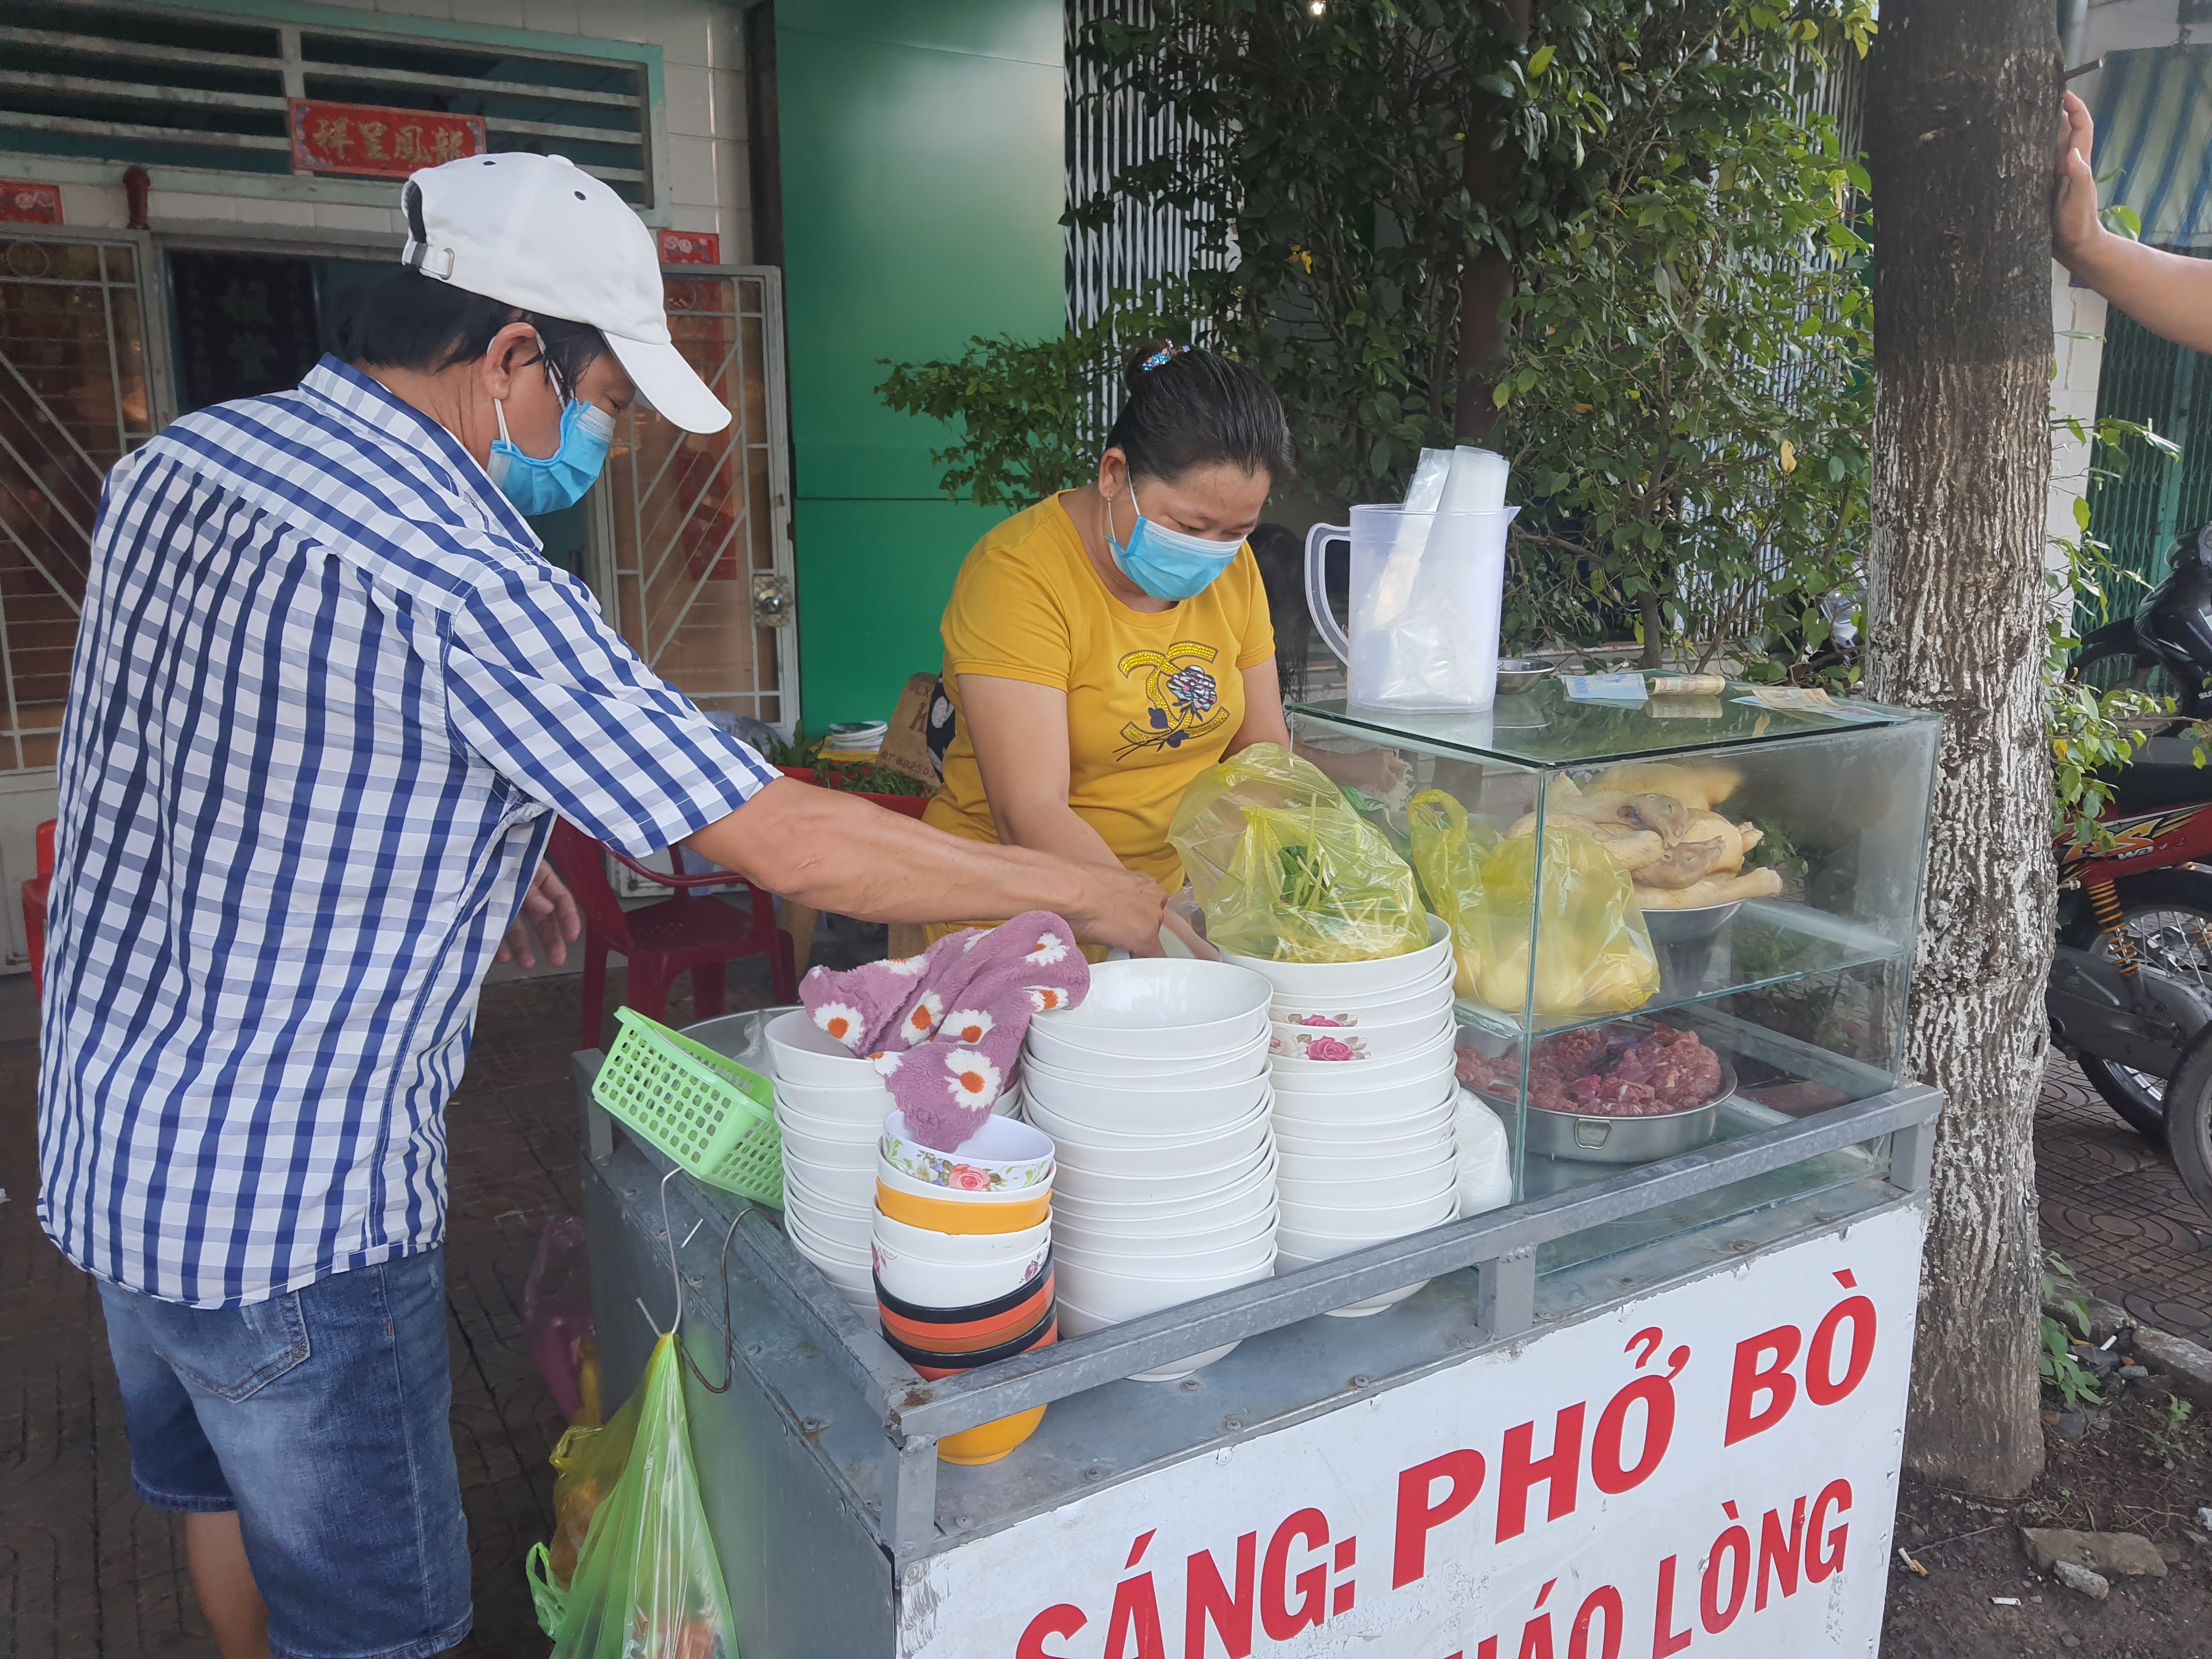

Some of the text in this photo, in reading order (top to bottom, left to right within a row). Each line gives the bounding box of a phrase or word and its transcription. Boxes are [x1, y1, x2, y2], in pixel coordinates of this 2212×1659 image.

[1392, 1327, 1691, 1591] PHỞ
[1724, 1268, 1877, 1448] BÒ
[1652, 1478, 1853, 1659] LÒNG
